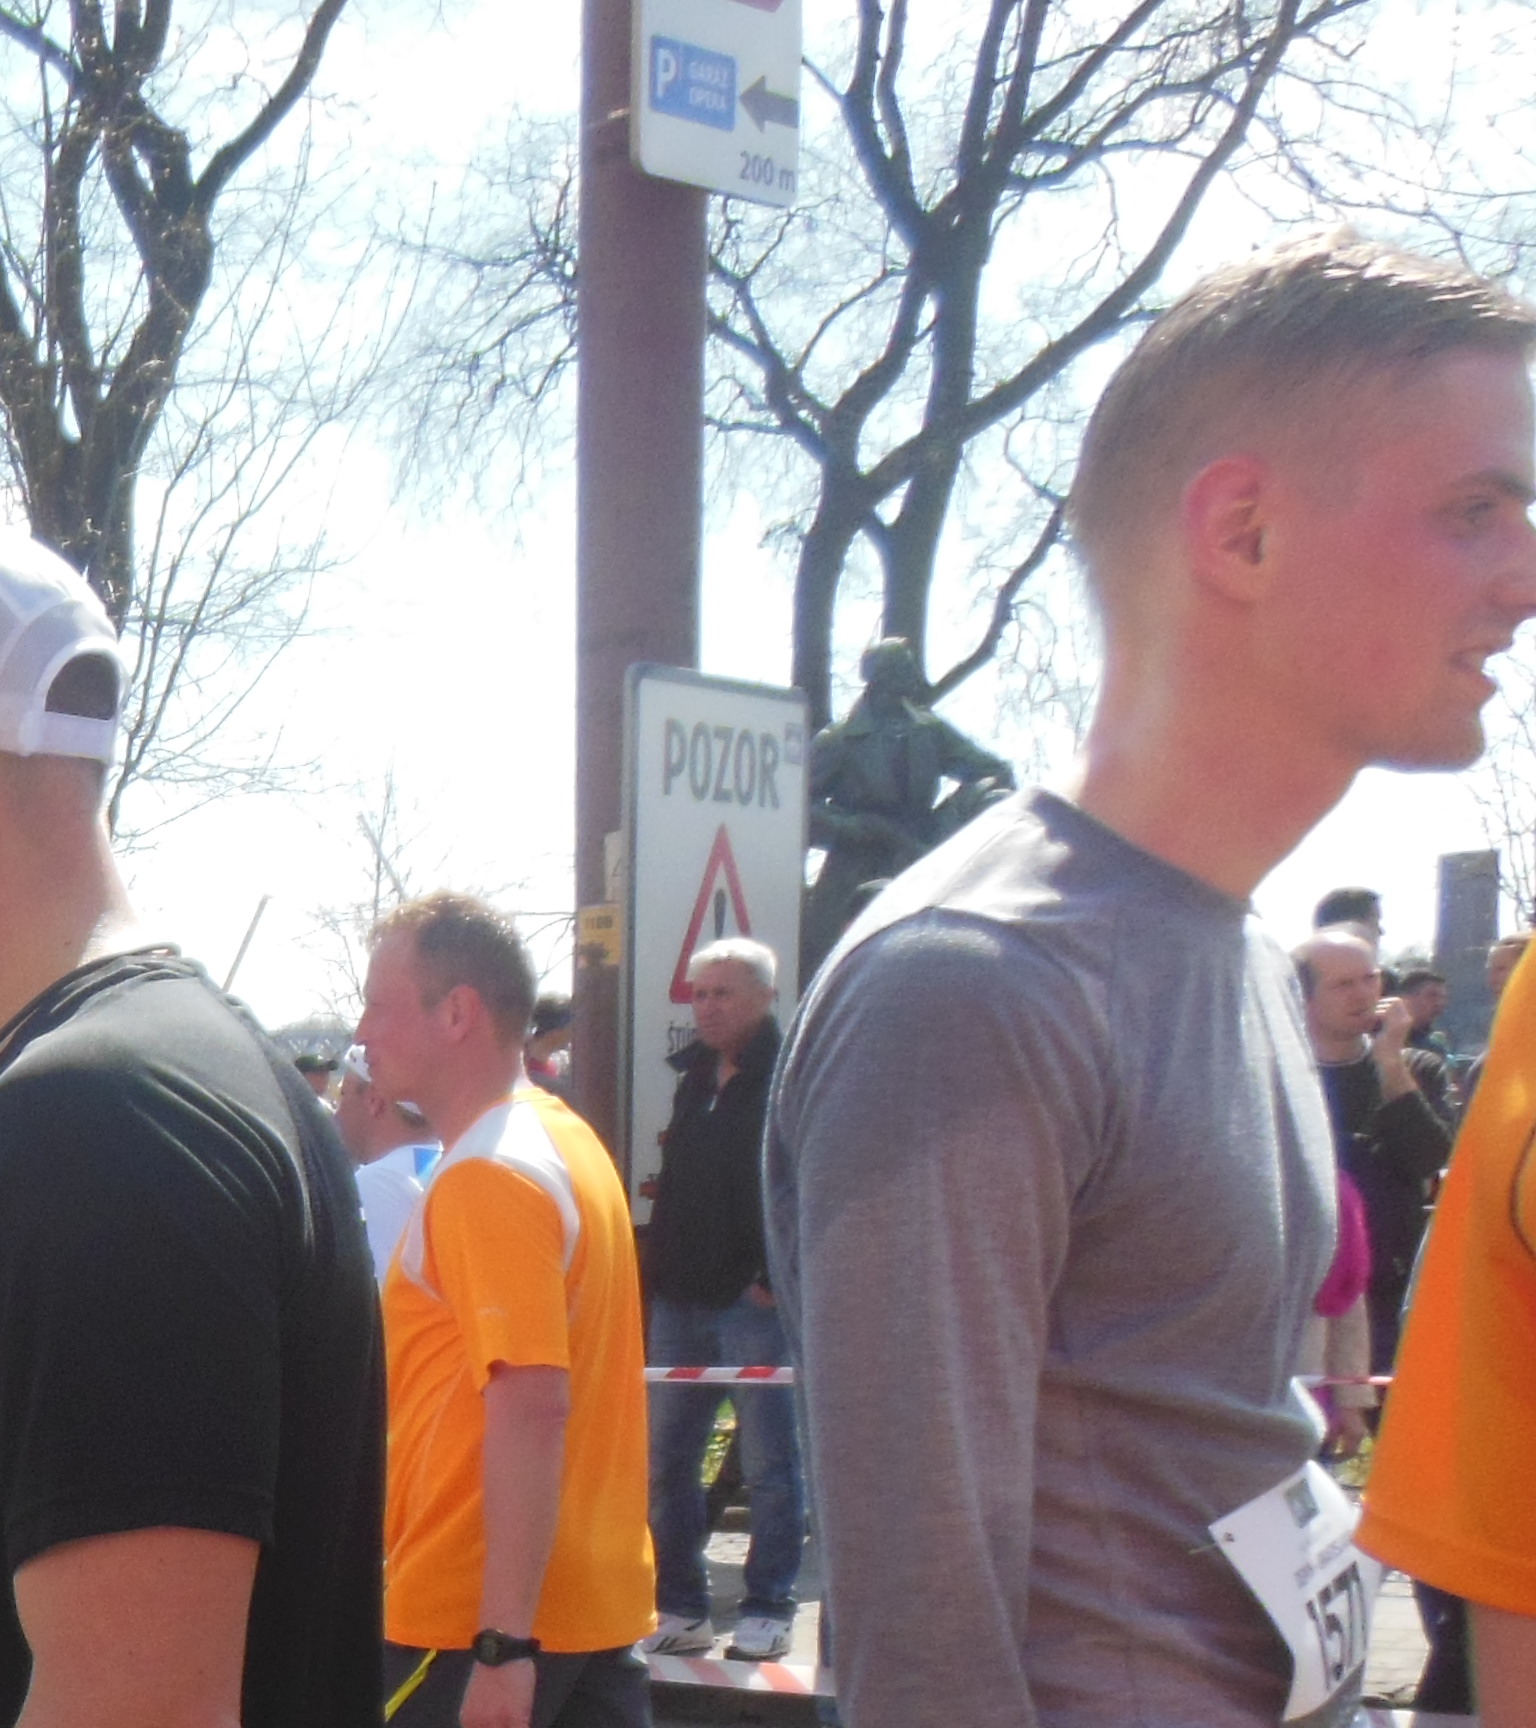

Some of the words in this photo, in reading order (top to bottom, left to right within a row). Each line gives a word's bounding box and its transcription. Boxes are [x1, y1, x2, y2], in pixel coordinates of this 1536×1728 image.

[739, 151, 775, 186] 200
[779, 168, 796, 193] m
[662, 717, 780, 809] POZOR
